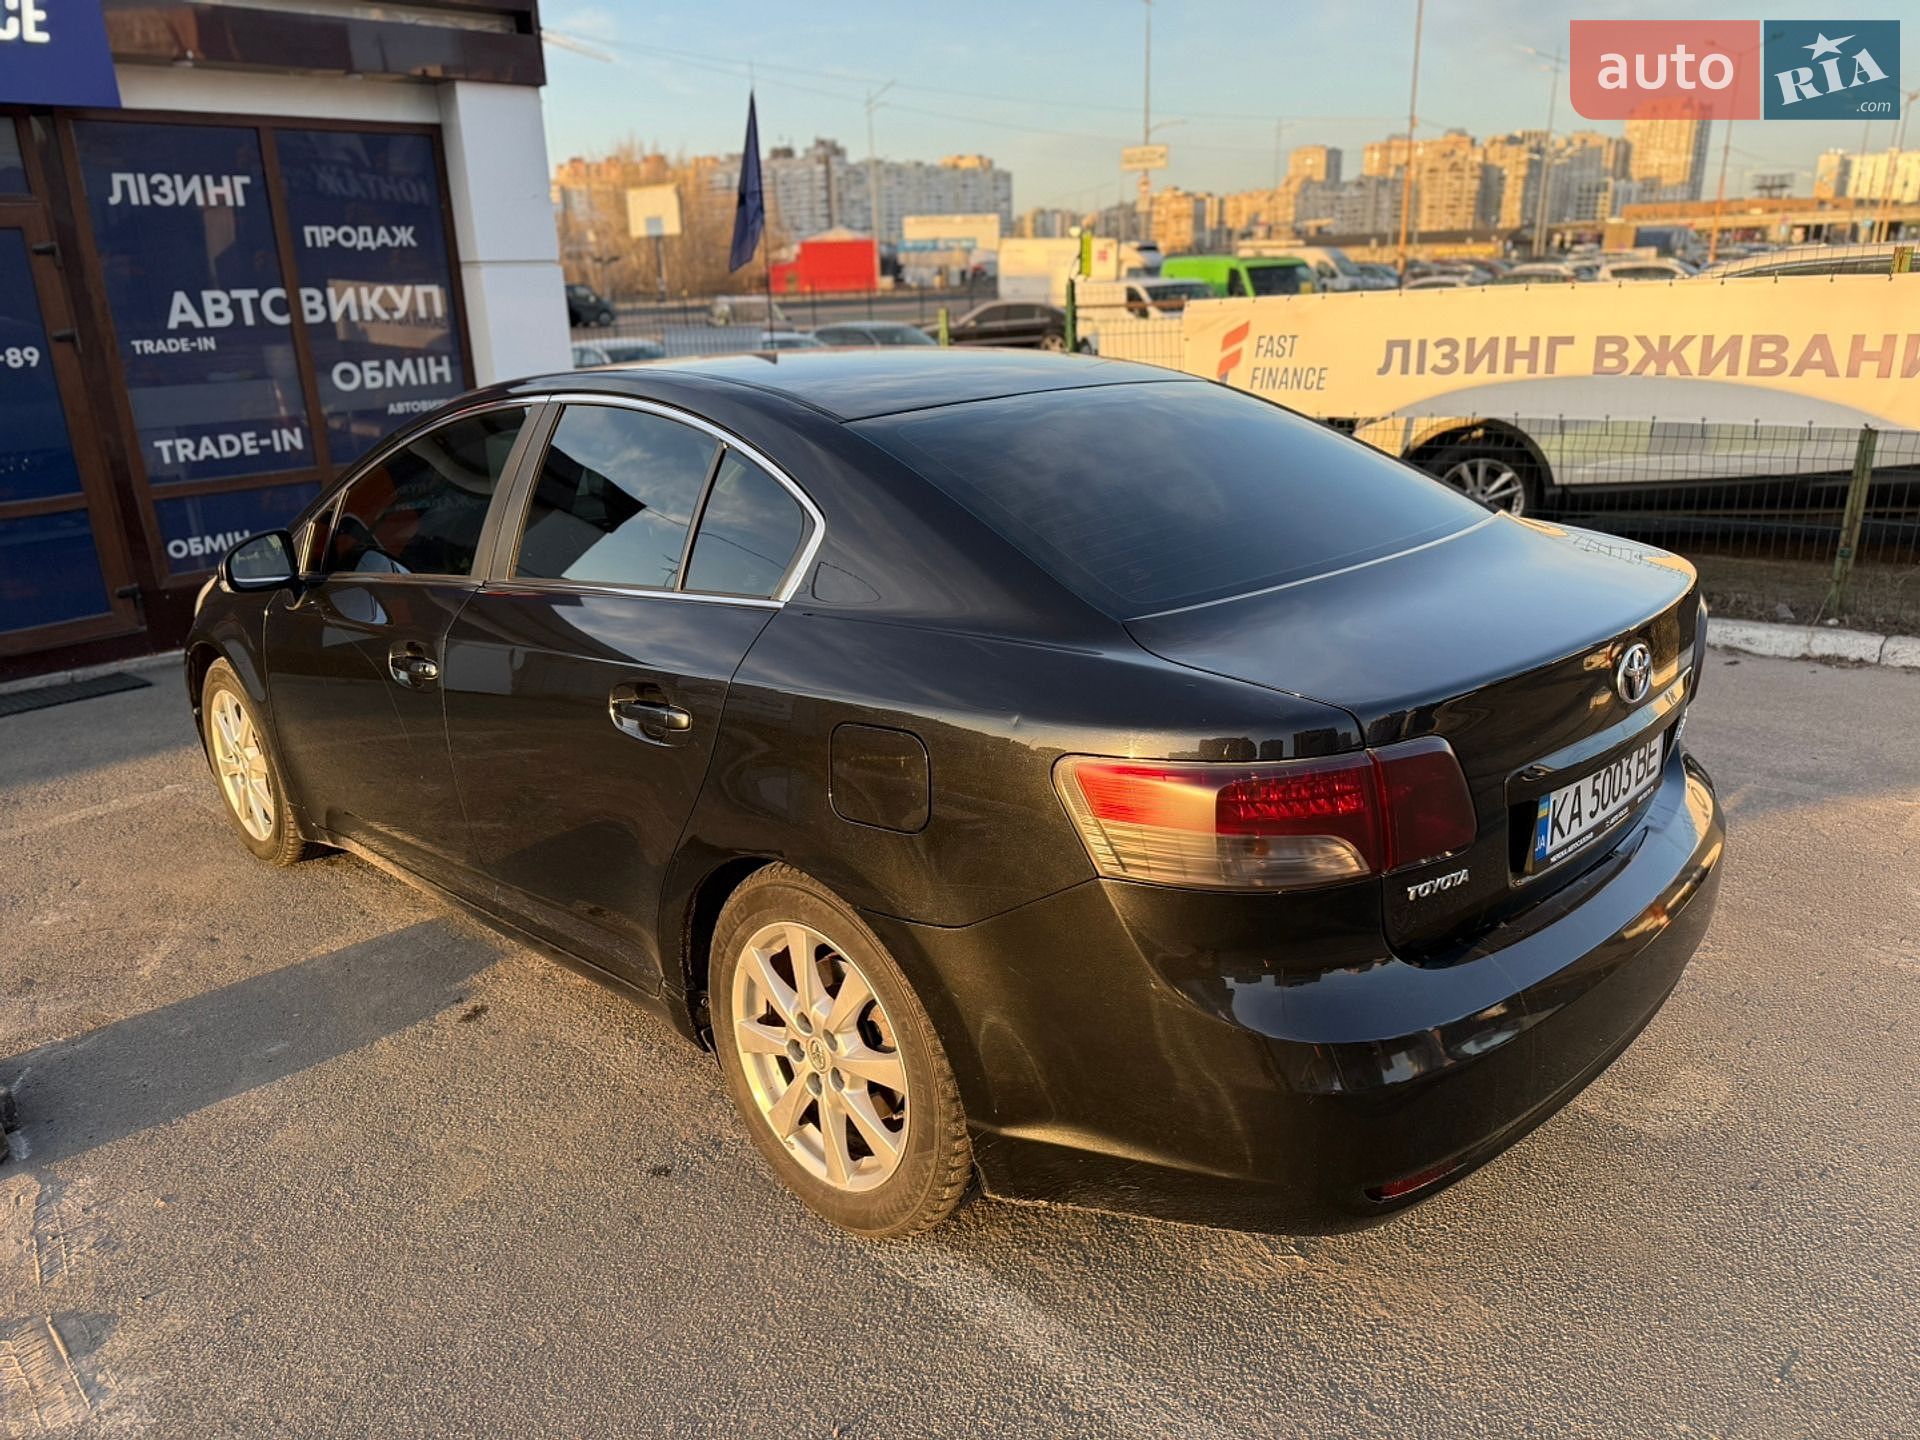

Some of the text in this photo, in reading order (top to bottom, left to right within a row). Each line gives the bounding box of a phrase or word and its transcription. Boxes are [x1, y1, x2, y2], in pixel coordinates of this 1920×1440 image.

[108, 172, 251, 207] ЛІЗИНГ
[303, 225, 418, 251] ПРОДАЖ
[131, 336, 217, 355] TRADE-IN
[1254, 335, 1299, 359] FAST
[1377, 335, 1575, 376] ЛІЗИНГ
[331, 355, 453, 392] ОБМІН
[1250, 367, 1329, 391] FINANCE
[153, 427, 305, 465] TRADE-IN
[1549, 783, 1582, 846] KA
[1589, 757, 1632, 819] 5003
[1407, 869, 1470, 901] TOYOTA
